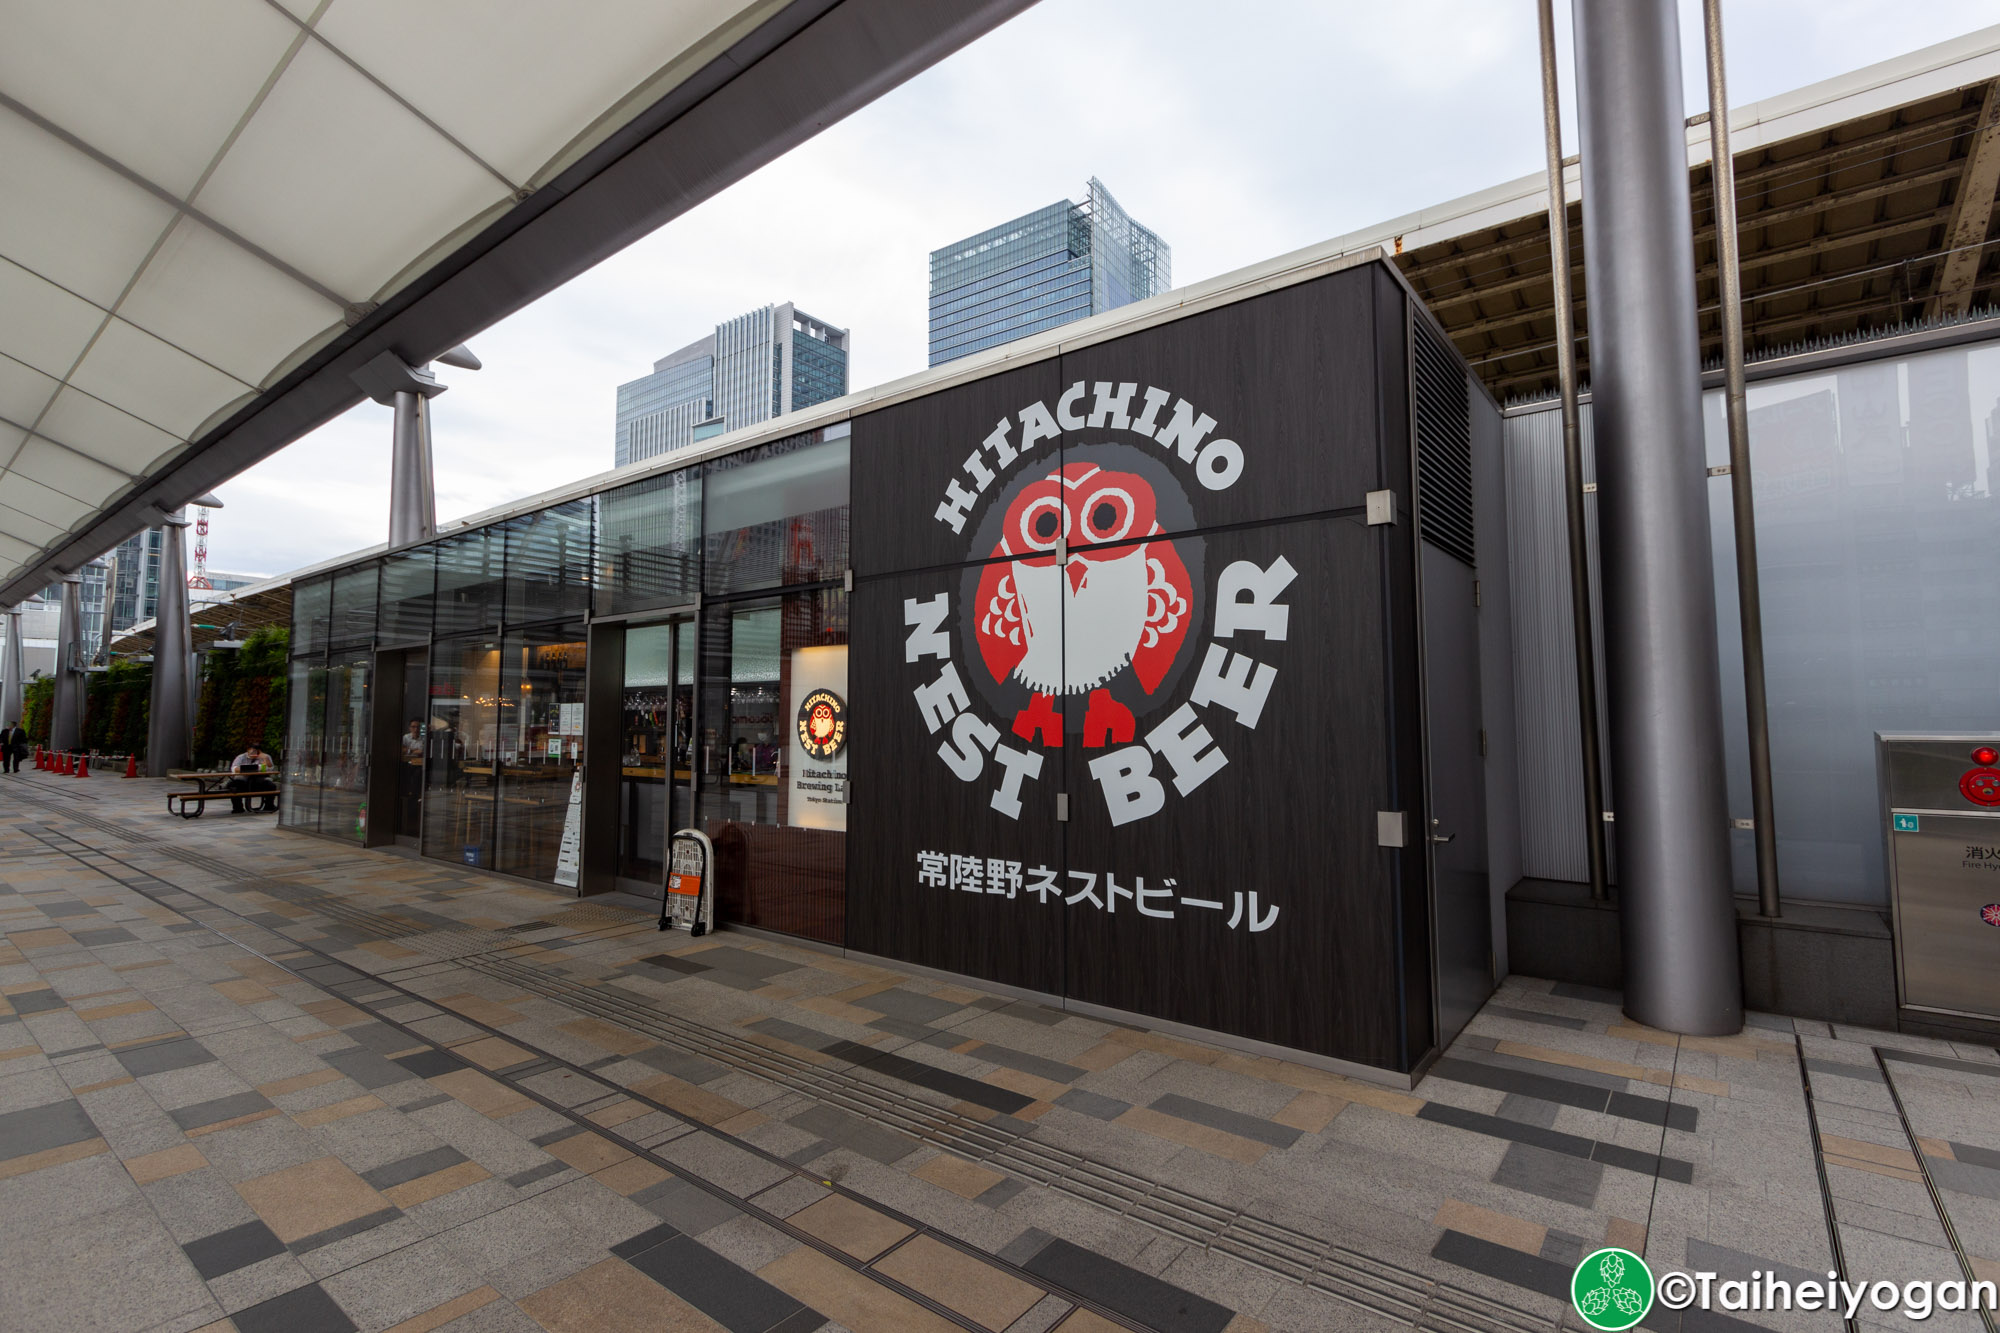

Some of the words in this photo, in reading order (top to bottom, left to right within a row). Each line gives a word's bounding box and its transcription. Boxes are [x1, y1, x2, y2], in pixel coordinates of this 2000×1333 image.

[934, 380, 1245, 535] HITACHINO
[804, 693, 841, 713] HITACHINO
[904, 592, 1044, 821] NEST
[1088, 554, 1299, 827] BEER
[800, 720, 818, 755] NEST
[822, 720, 844, 755] BEER
[796, 781, 833, 793] Brewing
[802, 768, 847, 780] Hitachno
[1962, 860, 1981, 869] Fire
[1983, 861, 2000, 872] Hy
[917, 850, 1280, 932] 常陸野ネストビール
